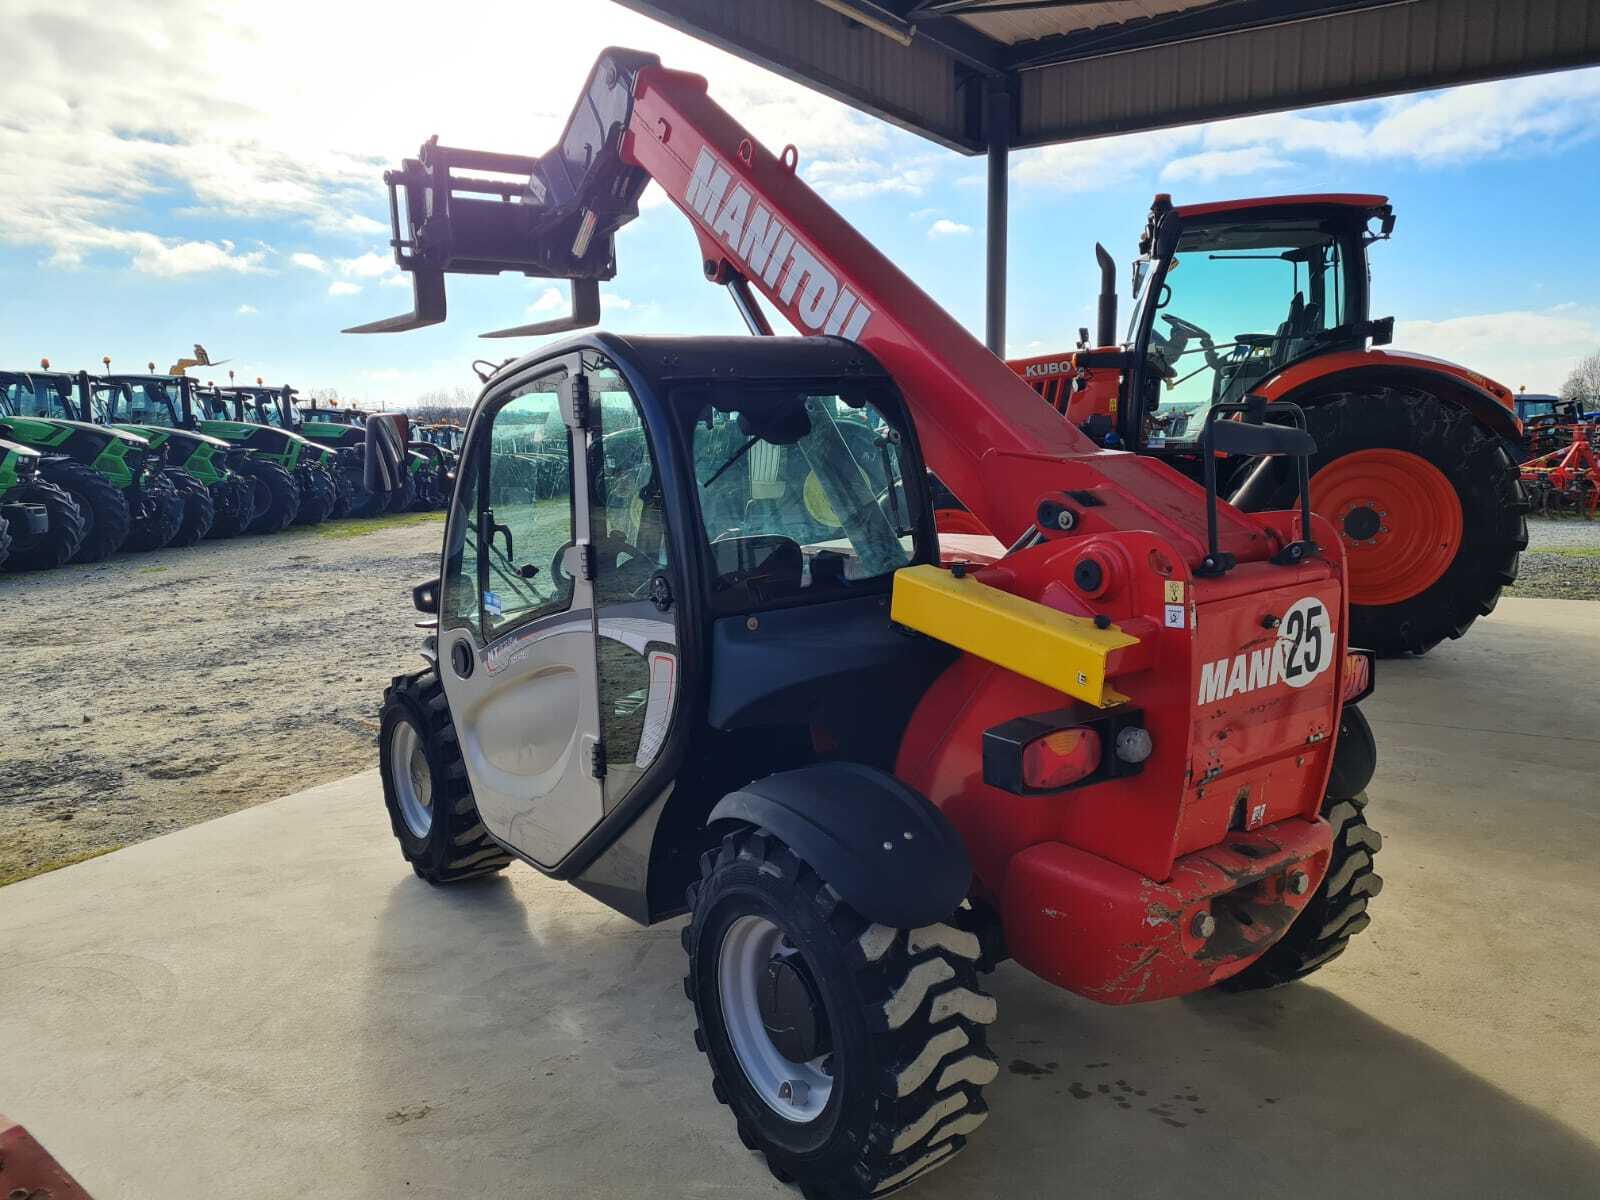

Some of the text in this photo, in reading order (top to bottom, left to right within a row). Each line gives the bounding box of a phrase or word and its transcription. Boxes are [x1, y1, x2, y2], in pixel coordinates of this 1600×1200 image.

[684, 145, 873, 343] MANITOU
[1026, 360, 1072, 377] KUBO
[1197, 632, 1336, 706] MANI
[1286, 605, 1322, 678] 25
